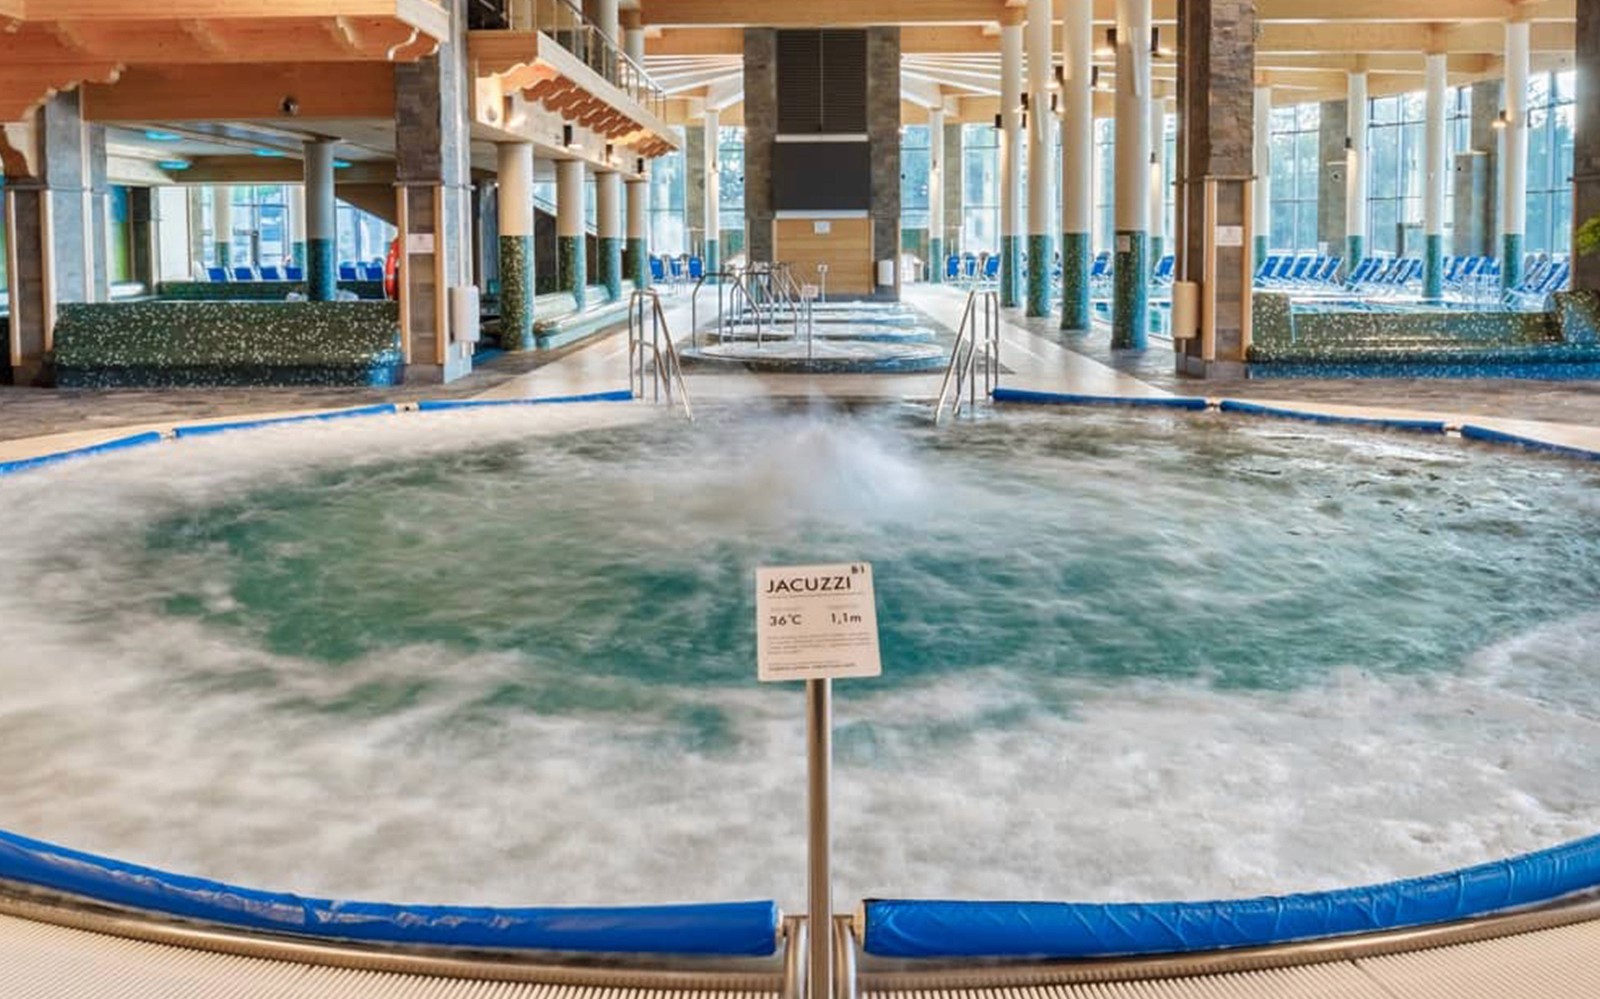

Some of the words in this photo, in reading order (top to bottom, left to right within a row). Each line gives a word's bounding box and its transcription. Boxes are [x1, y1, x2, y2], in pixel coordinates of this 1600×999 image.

[766, 576, 851, 593] JACUZZI
[769, 614, 802, 626] 36°C
[831, 612, 861, 625] 1,1m
